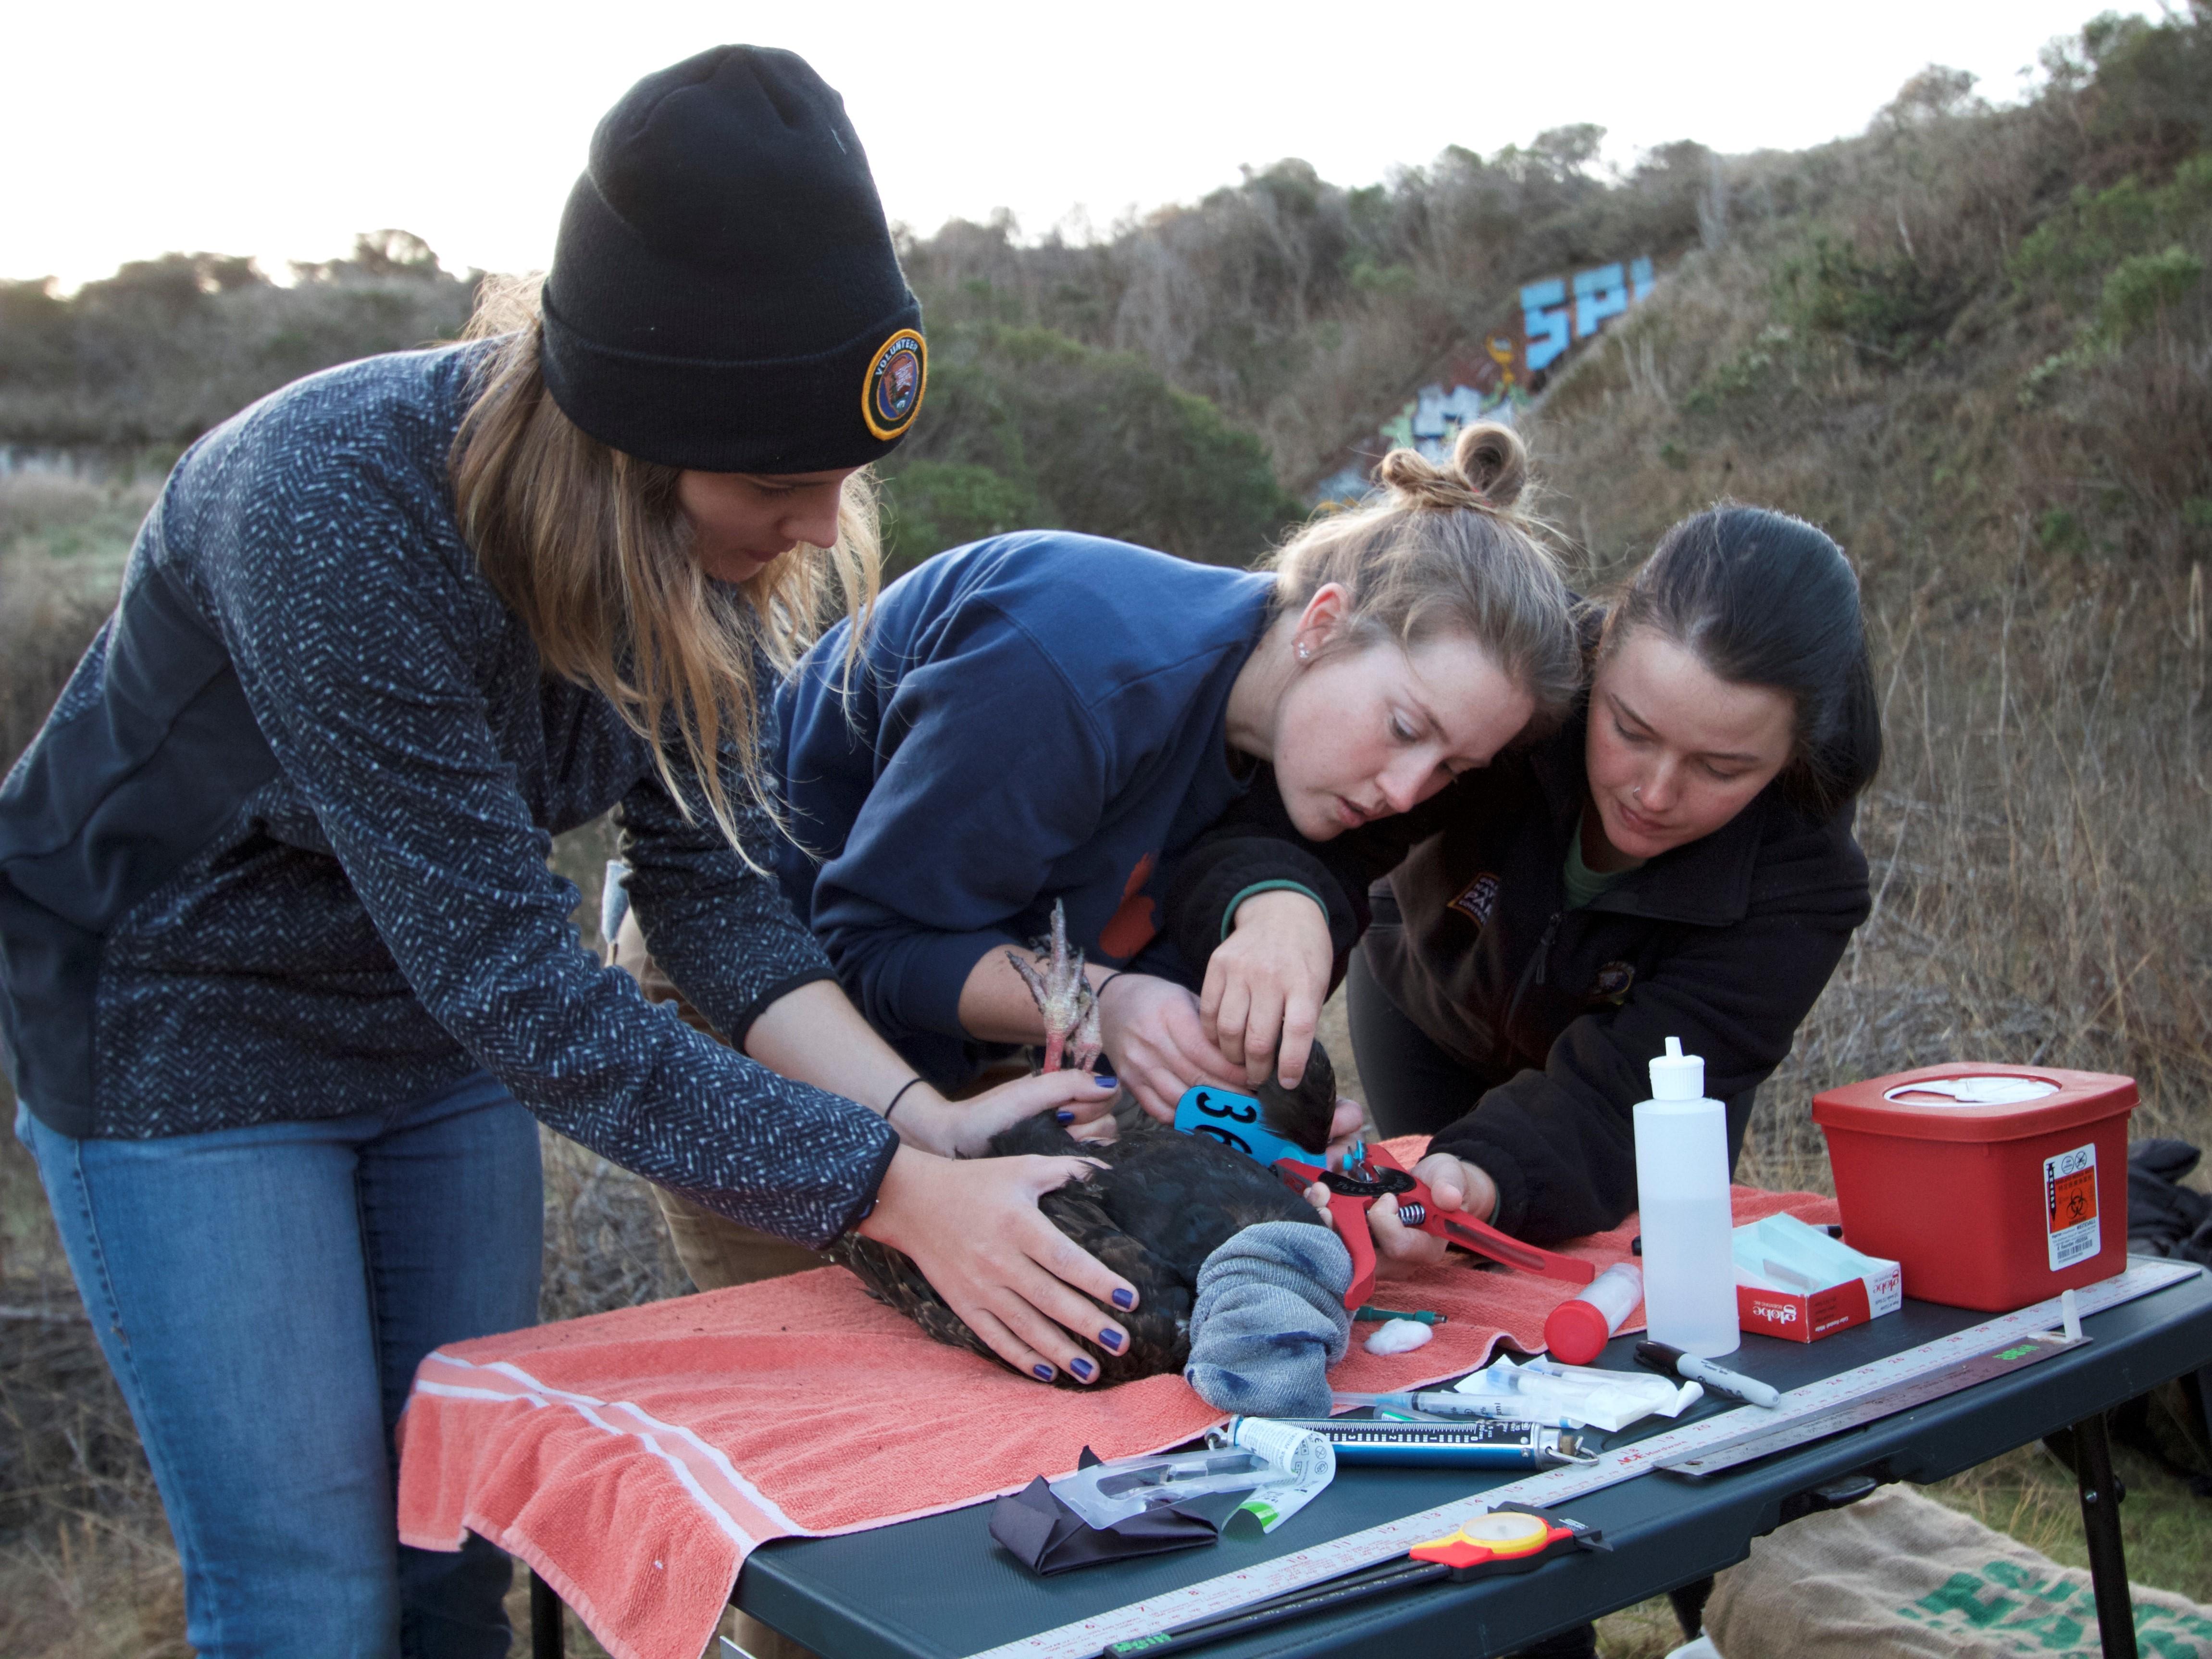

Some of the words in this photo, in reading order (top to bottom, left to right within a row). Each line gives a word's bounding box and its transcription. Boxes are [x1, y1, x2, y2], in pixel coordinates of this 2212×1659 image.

[875, 338, 918, 375] VOLUNTEER
[1752, 1304, 1797, 1324] globe
[1646, 1440, 1689, 1456] Hardware
[1504, 1485, 1524, 1493] 15
[1464, 1498, 1484, 1507] 14
[1421, 1512, 1442, 1520] 13
[1378, 1526, 1399, 1534] 12
[1286, 1555, 1308, 1563] 10
